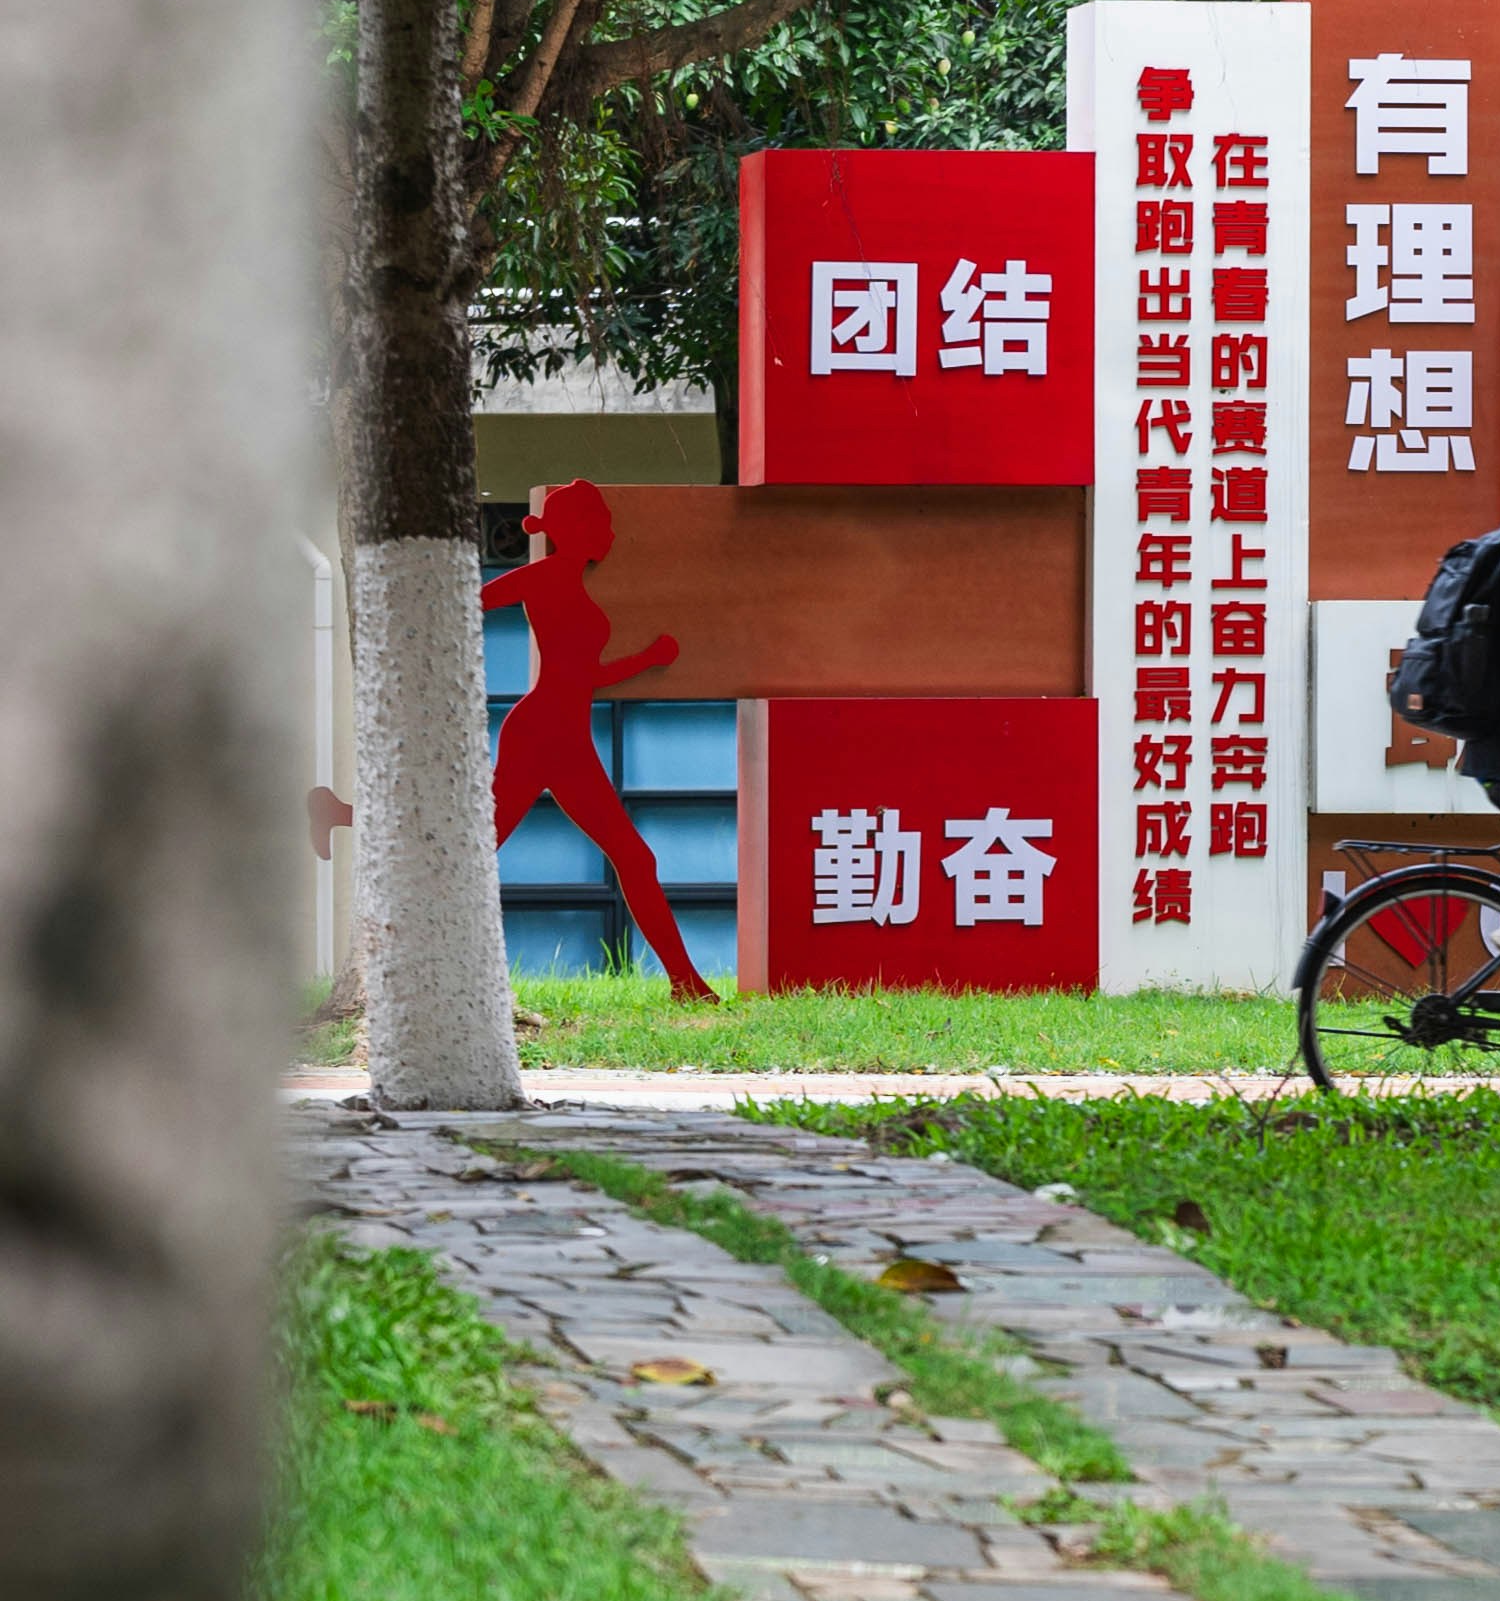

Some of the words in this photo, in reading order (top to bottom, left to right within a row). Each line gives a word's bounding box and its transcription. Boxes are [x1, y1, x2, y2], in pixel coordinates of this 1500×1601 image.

[810, 257, 1053, 377] 团结
[1345, 53, 1476, 472] 有理想
[1133, 66, 1195, 925] 争取跑出当代青年的最好成绩
[1209, 132, 1270, 859] 在青春的赛道上奋力奔跑
[811, 806, 1058, 927] 勤奋
